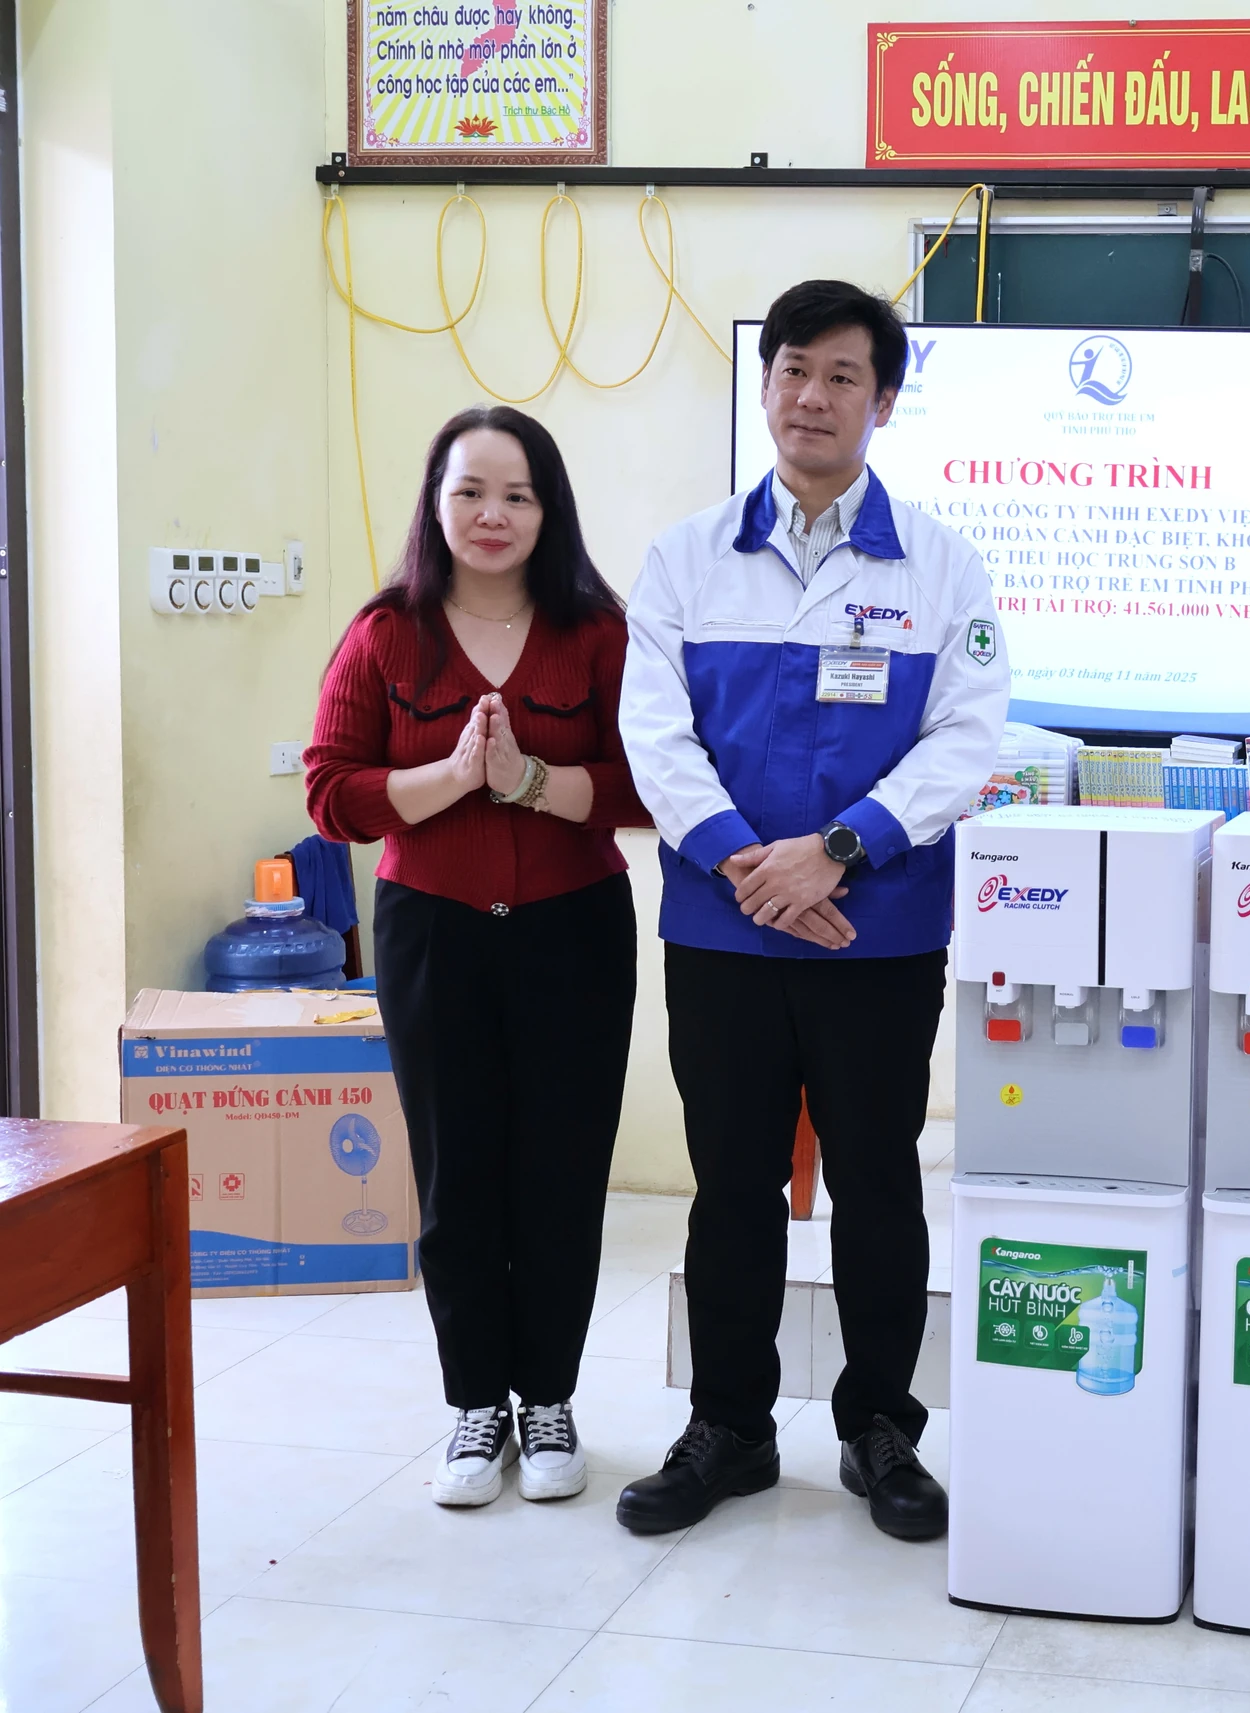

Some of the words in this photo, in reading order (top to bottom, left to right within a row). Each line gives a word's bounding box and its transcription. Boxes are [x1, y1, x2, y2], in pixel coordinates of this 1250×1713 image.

[377, 6, 407, 26] năm
[414, 7, 448, 26] châu
[454, 6, 490, 30] được
[496, 6, 522, 29] hay
[529, 5, 576, 30] không.
[377, 38, 415, 60] Chính
[421, 40, 434, 60] là
[439, 38, 464, 60] nhờ
[470, 40, 496, 64] một
[501, 34, 537, 63] phần
[541, 38, 562, 59] lớn
[567, 35, 577, 59] ở
[377, 73, 412, 98] công
[416, 74, 442, 99] học
[446, 74, 469, 98] tập
[473, 70, 500, 93] của
[503, 71, 530, 93] các
[911, 53, 1007, 133] SỐNG,
[1018, 53, 1115, 127] CHIẾN
[1124, 50, 1199, 133] ĐẤU,
[943, 456, 1094, 487] CHƯƠNG
[1104, 456, 1212, 489] TRÌNH
[948, 497, 987, 517] CỦA
[992, 499, 1048, 519] CÔNG
[1055, 503, 1080, 520] TY
[1084, 504, 1140, 521] TNHH
[1147, 506, 1212, 523] EXEDY
[992, 523, 1047, 542] HOÀN
[1057, 550, 1099, 570] HỌC
[1104, 553, 1173, 570] TRUNG
[1179, 553, 1217, 571] SƠN
[1224, 556, 1236, 571] B
[1049, 574, 1090, 594] TRỢ
[1140, 577, 1169, 593] EM
[845, 603, 908, 620] EXEDY
[995, 596, 1027, 615] TRỊ
[1033, 593, 1065, 613] TÀI
[1071, 598, 1117, 618] TRỢ:
[1123, 601, 1210, 617] 41.561.000
[1027, 667, 1056, 681] ngày
[1058, 667, 1075, 678] 03
[1077, 668, 1113, 683] tháng
[1117, 670, 1131, 681] 11
[1134, 671, 1161, 682] năm
[1164, 671, 1198, 683] 2025
[970, 851, 1018, 863] Kangaroo
[998, 886, 1069, 902] EXEDY
[1004, 902, 1030, 910] RACING
[1032, 903, 1060, 911] CLUTCH
[155, 1043, 252, 1059] Vinawind
[156, 1064, 177, 1075] ĐIỆN
[149, 1090, 207, 1115] QUẠT
[212, 1085, 270, 1109] ĐỨNG
[275, 1084, 332, 1106] CÁNH
[338, 1087, 372, 1105] 450
[225, 1112, 252, 1120] Model:
[991, 1247, 1041, 1261] Kangaroo
[989, 1278, 1026, 1297] CÂY
[1029, 1282, 1082, 1304] NƯỚC
[988, 1295, 1022, 1314] HÚT
[1026, 1302, 1067, 1318] BÌNH
